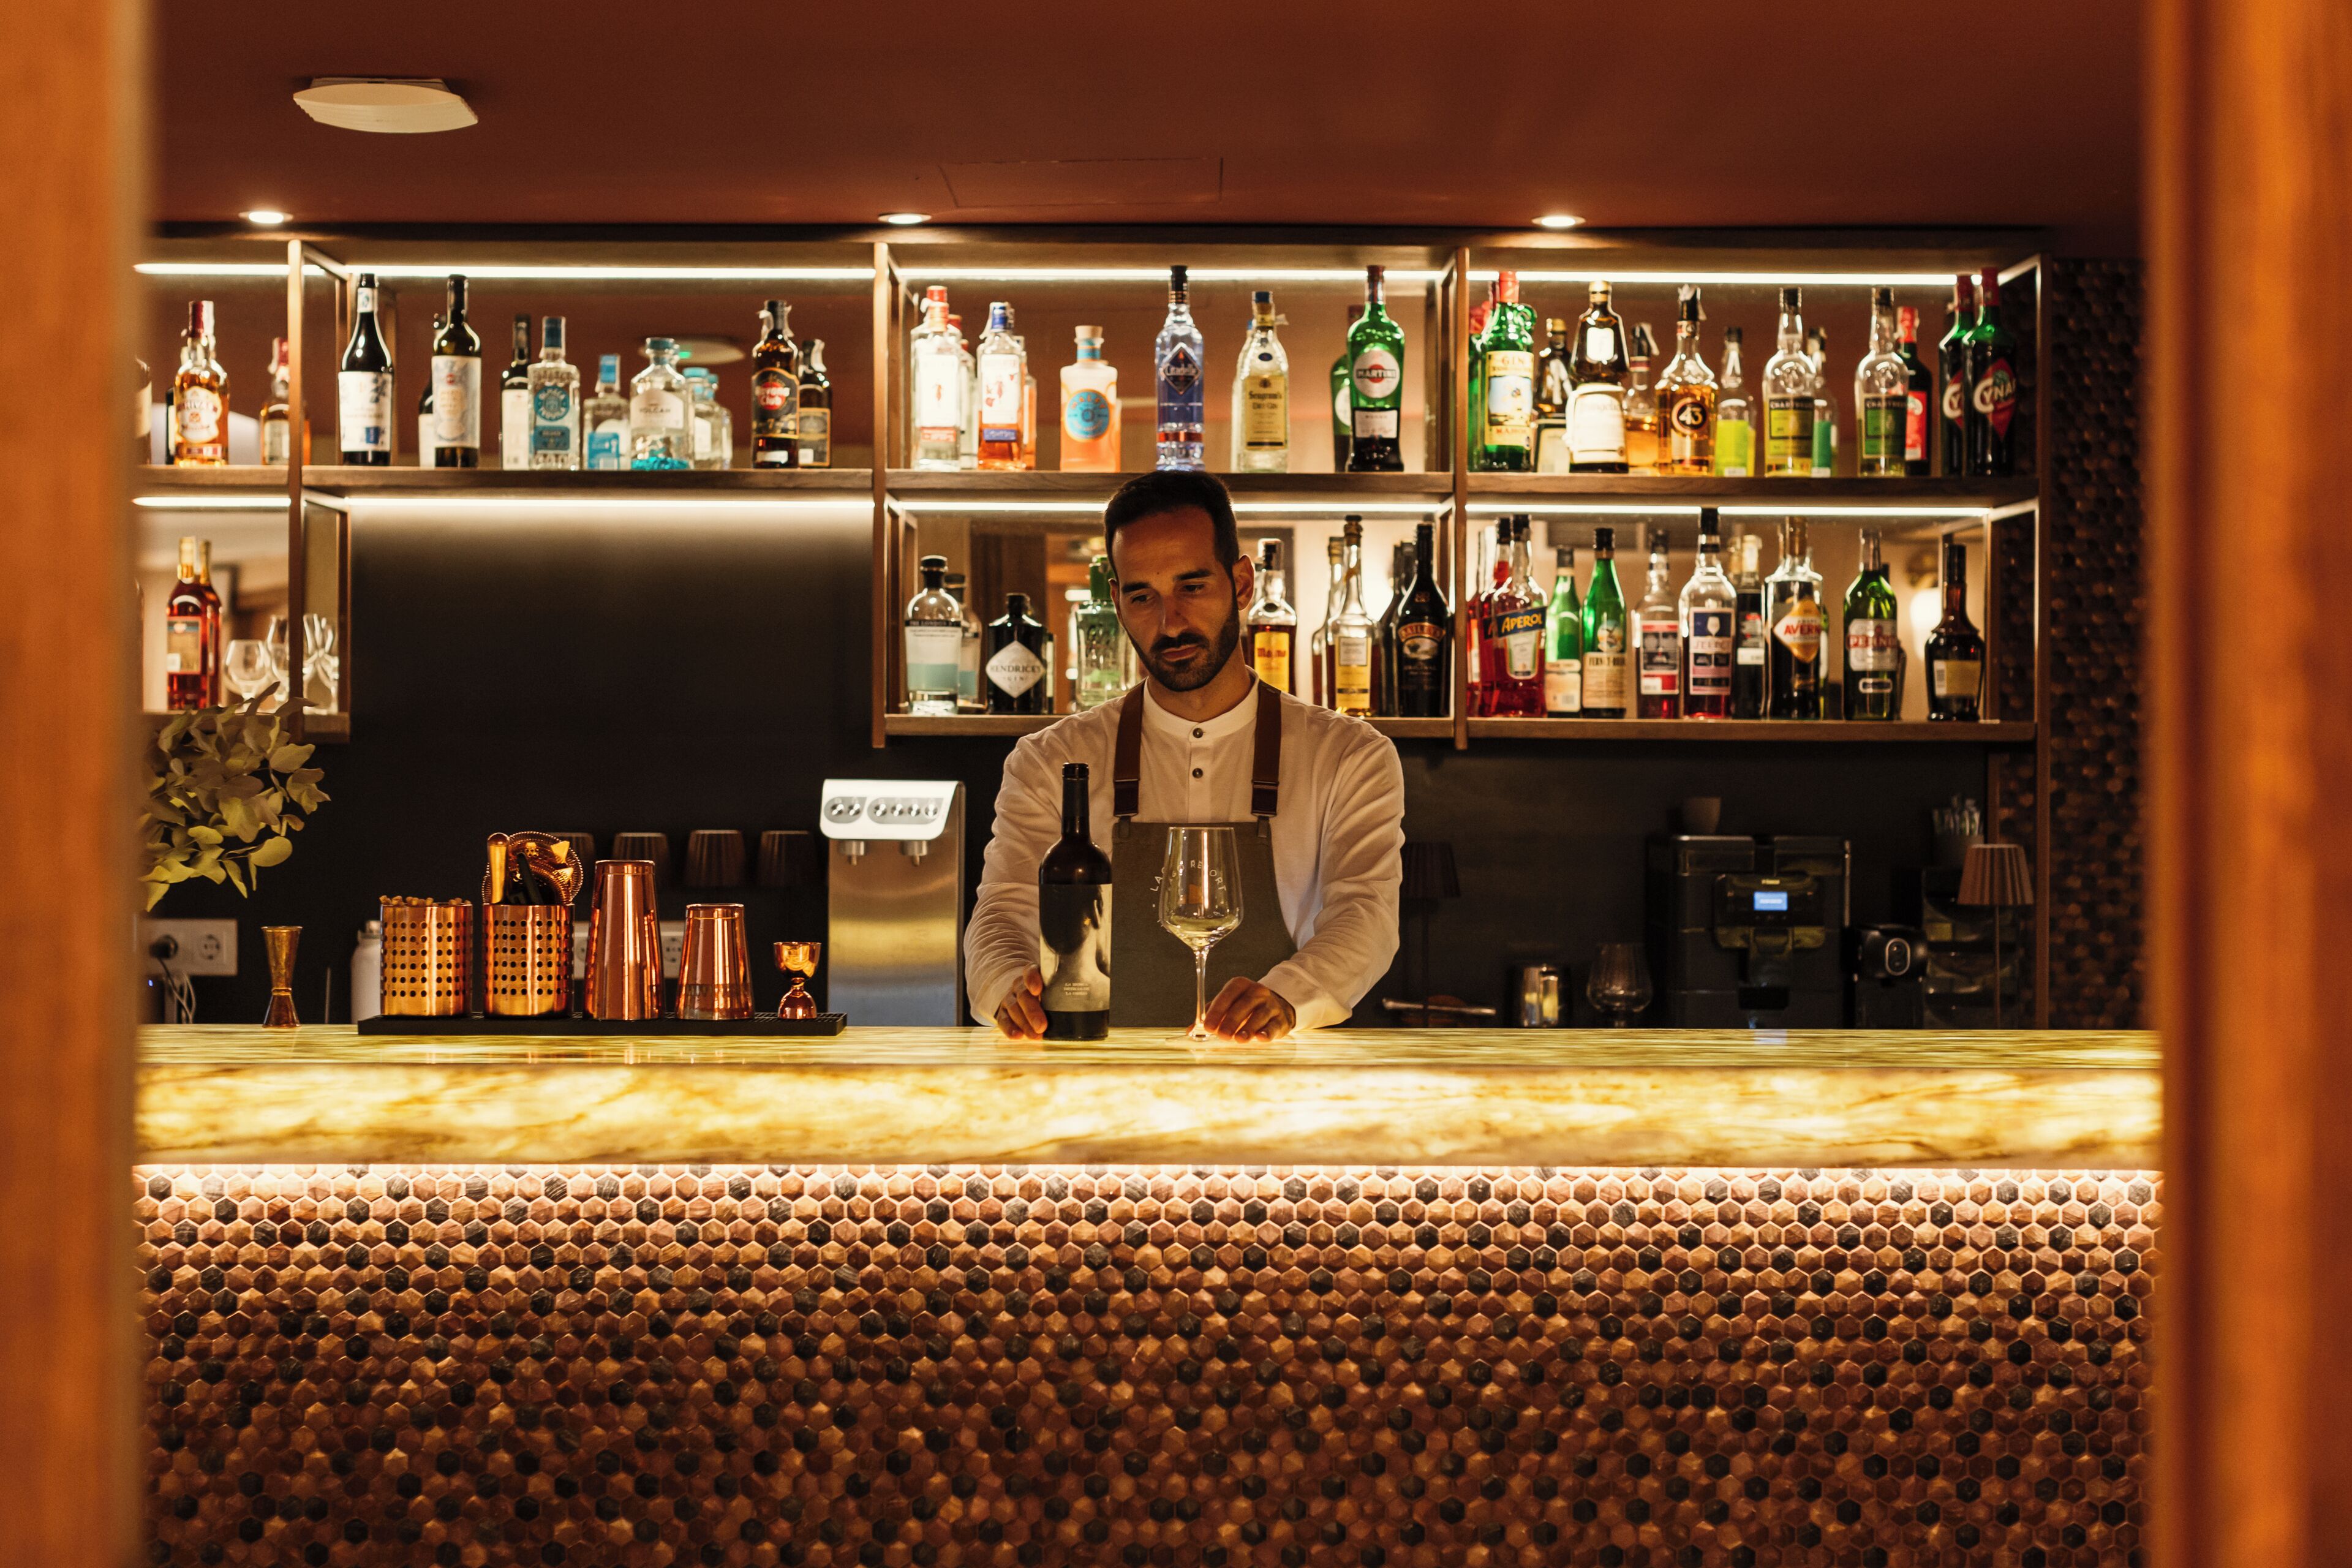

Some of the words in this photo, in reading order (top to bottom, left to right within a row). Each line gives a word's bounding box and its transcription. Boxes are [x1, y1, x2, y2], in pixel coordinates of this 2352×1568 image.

[1501, 355, 1525, 366] GIN
[1679, 407, 1703, 425] 43
[1501, 613, 1543, 633] APEROL
[1784, 624, 1821, 635] AVERN
[1190, 859, 1227, 891] REORT
